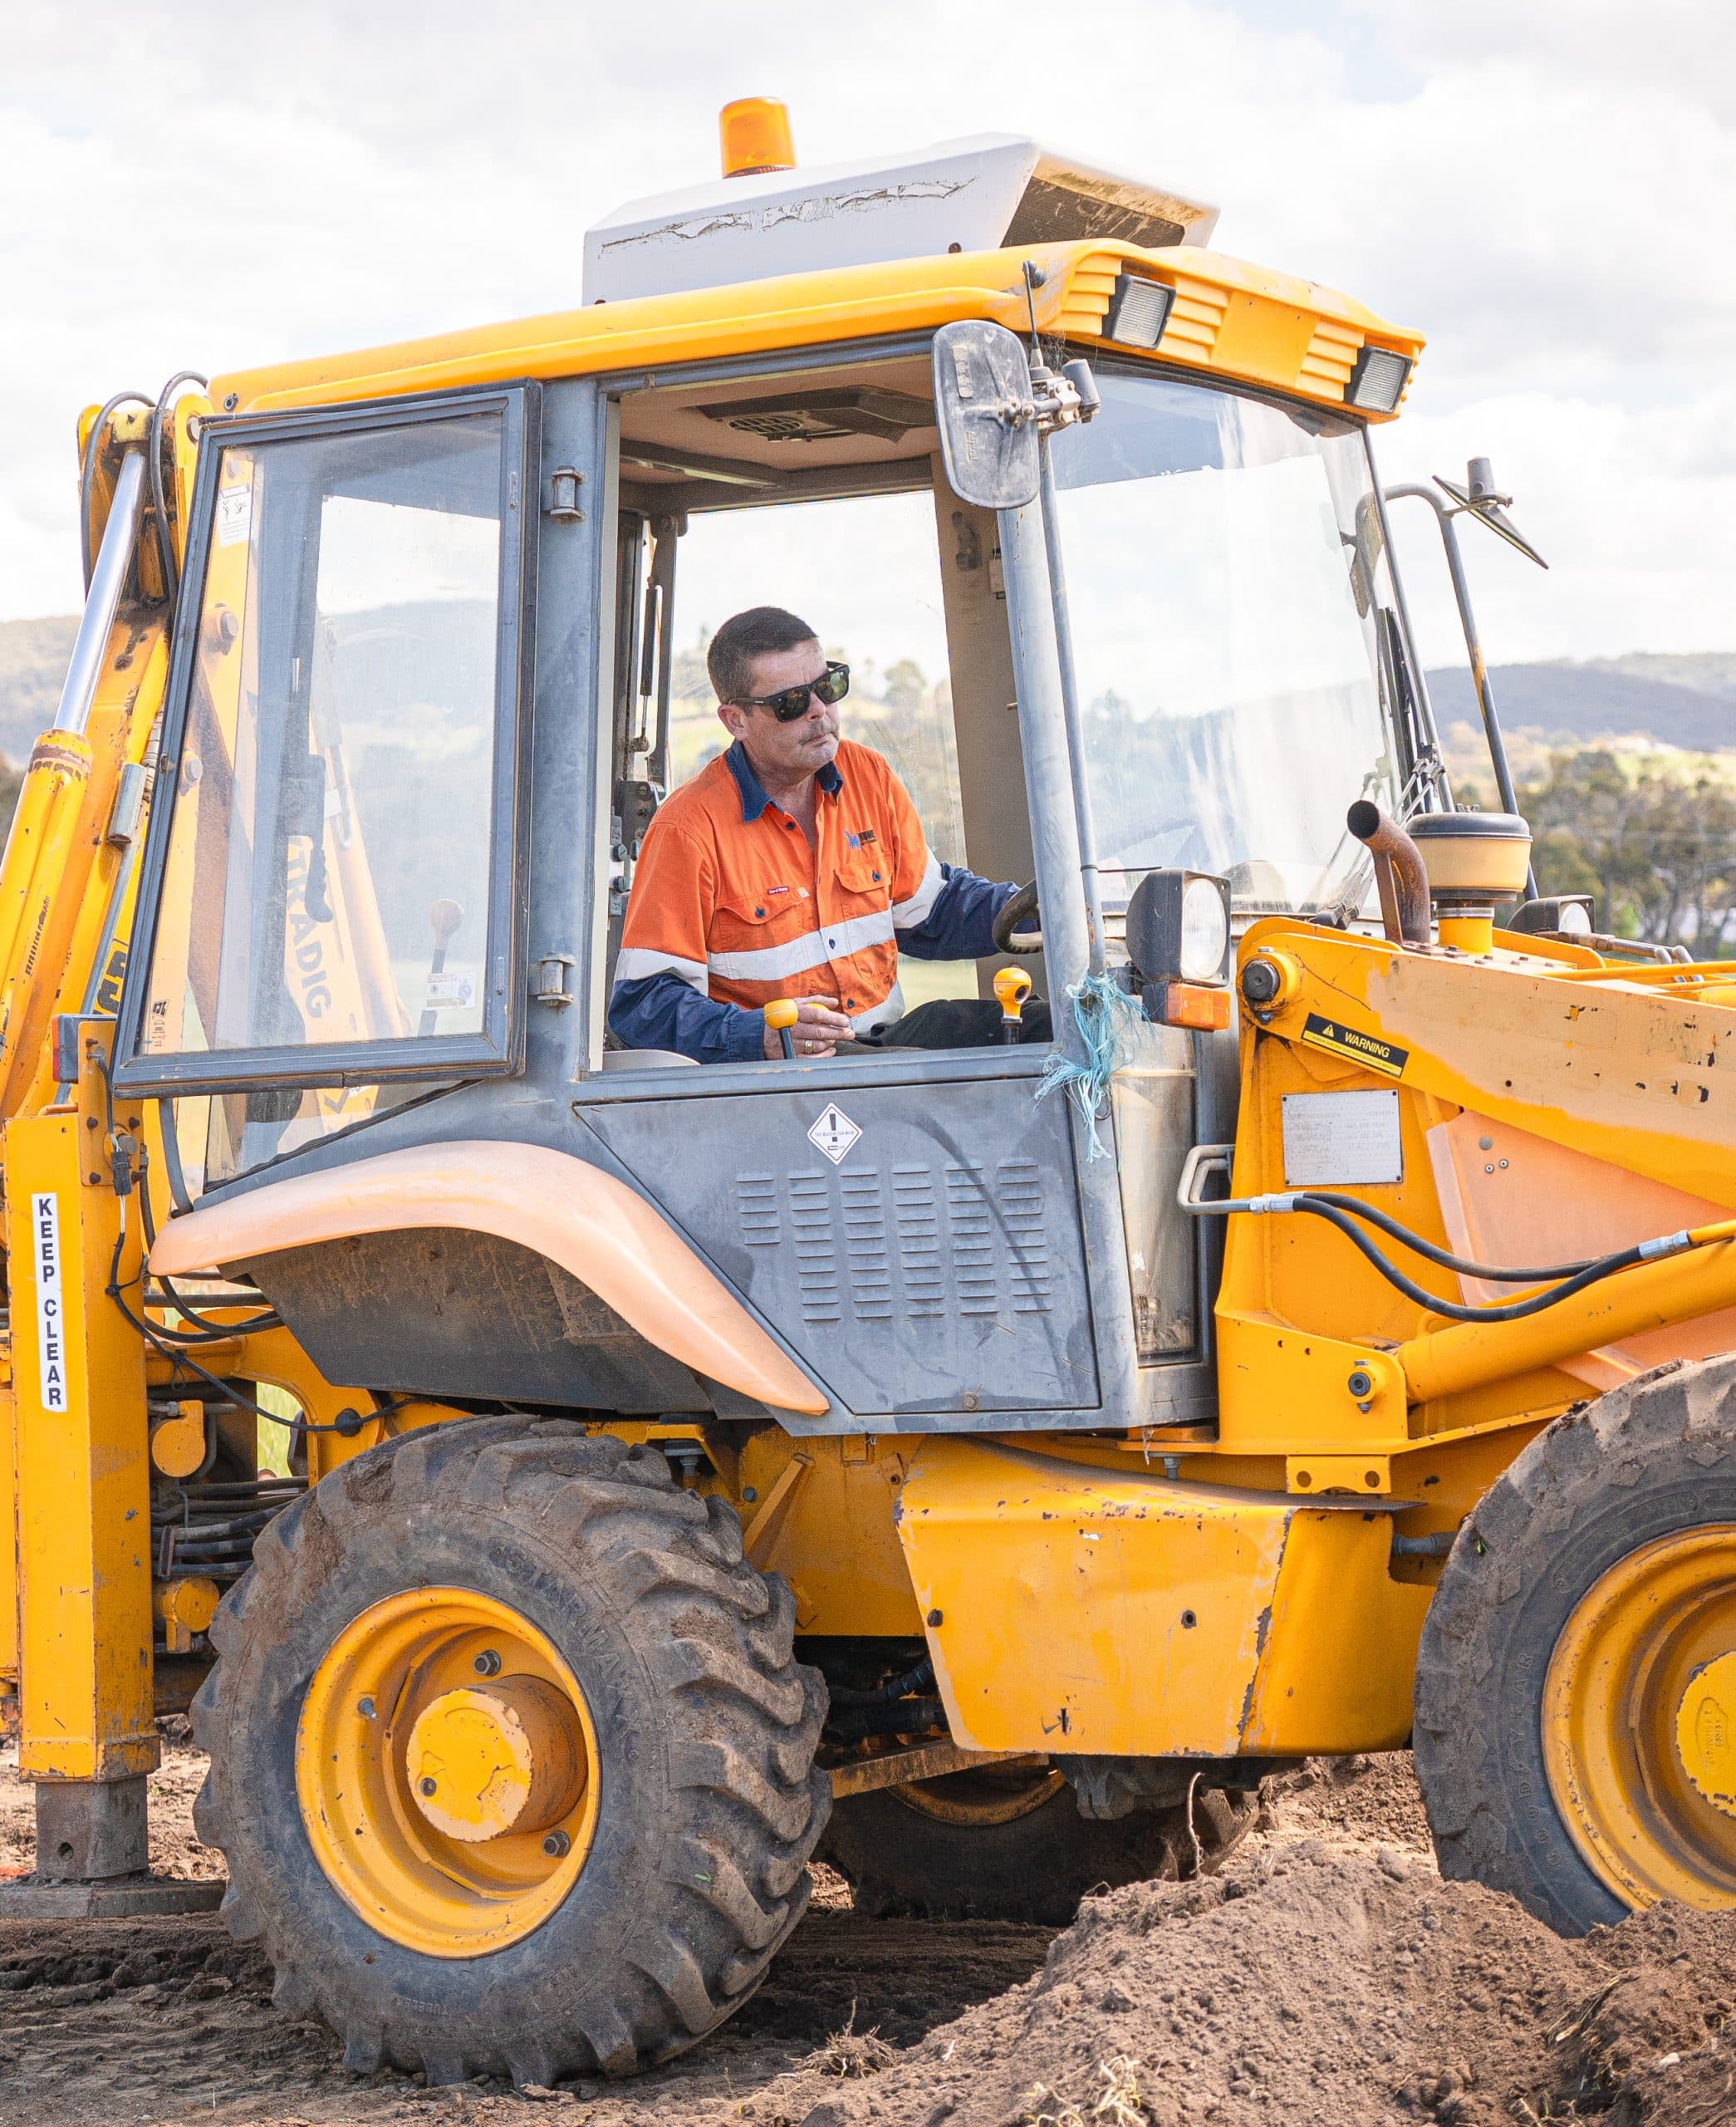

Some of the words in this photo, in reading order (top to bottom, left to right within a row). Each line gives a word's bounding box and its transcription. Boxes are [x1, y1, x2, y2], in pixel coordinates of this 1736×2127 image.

[287, 834, 331, 1019] TRADIG
[1345, 1032, 1390, 1058] WARNING
[38, 1197, 56, 1283] KEEP
[44, 1299, 61, 1406] CLEAR
[1509, 1653, 1562, 1866] GOODYEAR
